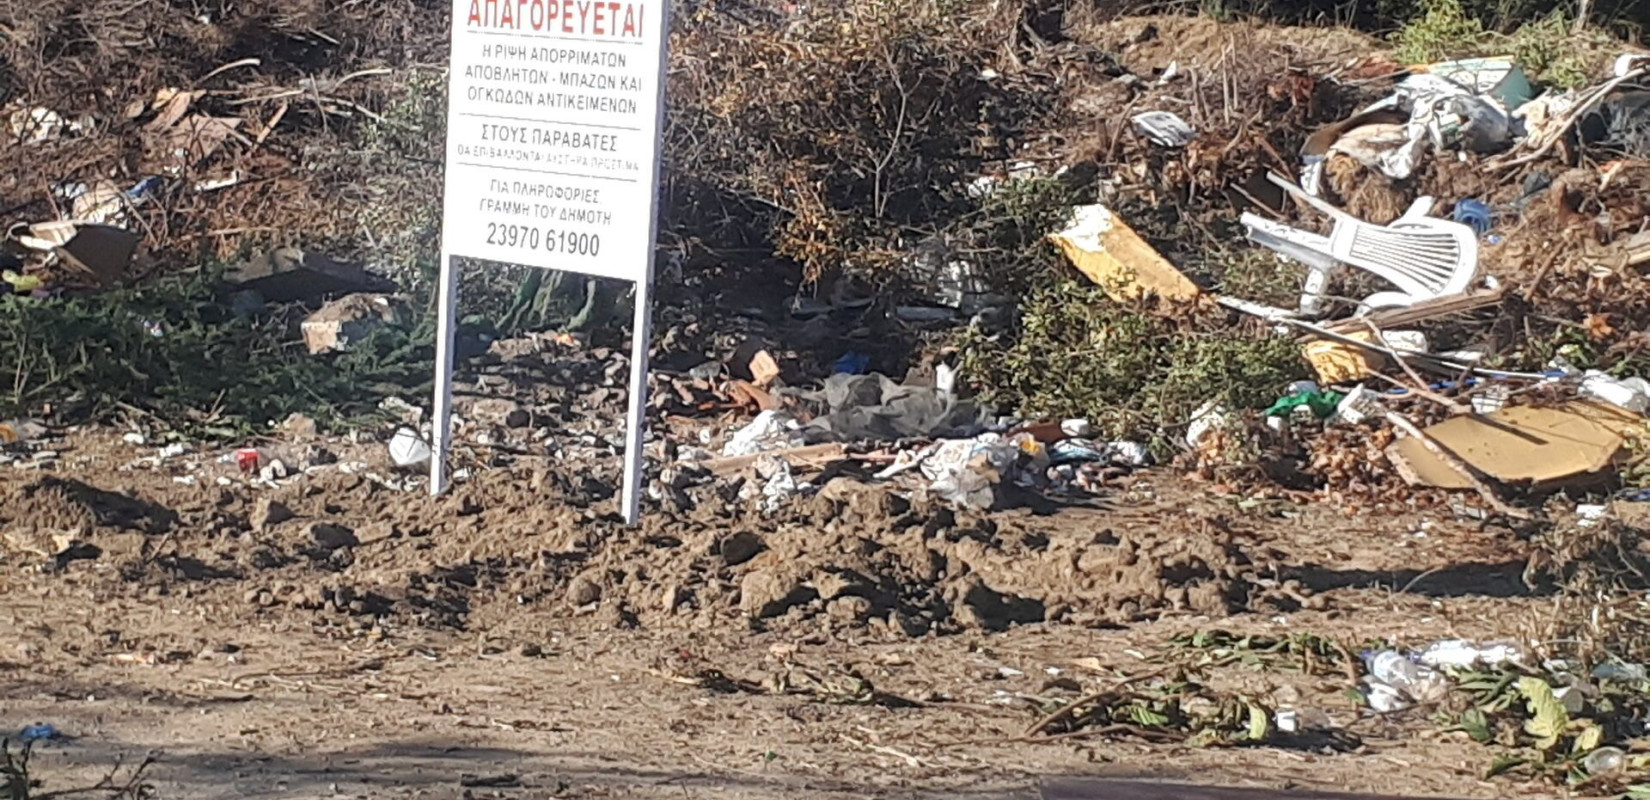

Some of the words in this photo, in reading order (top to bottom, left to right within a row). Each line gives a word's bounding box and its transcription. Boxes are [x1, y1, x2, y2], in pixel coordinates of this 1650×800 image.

[467, 0, 644, 38] ΑΠΑΓΟΡΕΥΕΤΑΙ
[482, 44, 491, 57] Η
[495, 45, 527, 61] ΡΙΨΗ
[530, 48, 626, 68] ΑΠΟΡΡΙΜΑΤΩΝ
[465, 65, 548, 84] ΑΠΟΒΛΗΤΩΝ
[559, 72, 616, 90] ΜΠΑΖΩΝ
[620, 76, 642, 92] ΚΑΙ
[468, 86, 533, 106] ΟΓΚΩΔΩΝ
[537, 93, 636, 114] ΑΝΤΙΚΕΙΜΕΝΩΝ
[481, 124, 527, 143] ΣΤΟΥΣ
[532, 129, 618, 151] ΠΑΡΑΒΑΤΕΣ
[490, 179, 509, 194] ΓΙΑ
[479, 198, 530, 216] ΓΡΑΜΜΗ
[534, 203, 557, 219] ΤΟΥ
[559, 207, 612, 225] ΔΗΜΟΤΗ
[486, 222, 540, 250] 23970
[545, 228, 600, 257] 61900
